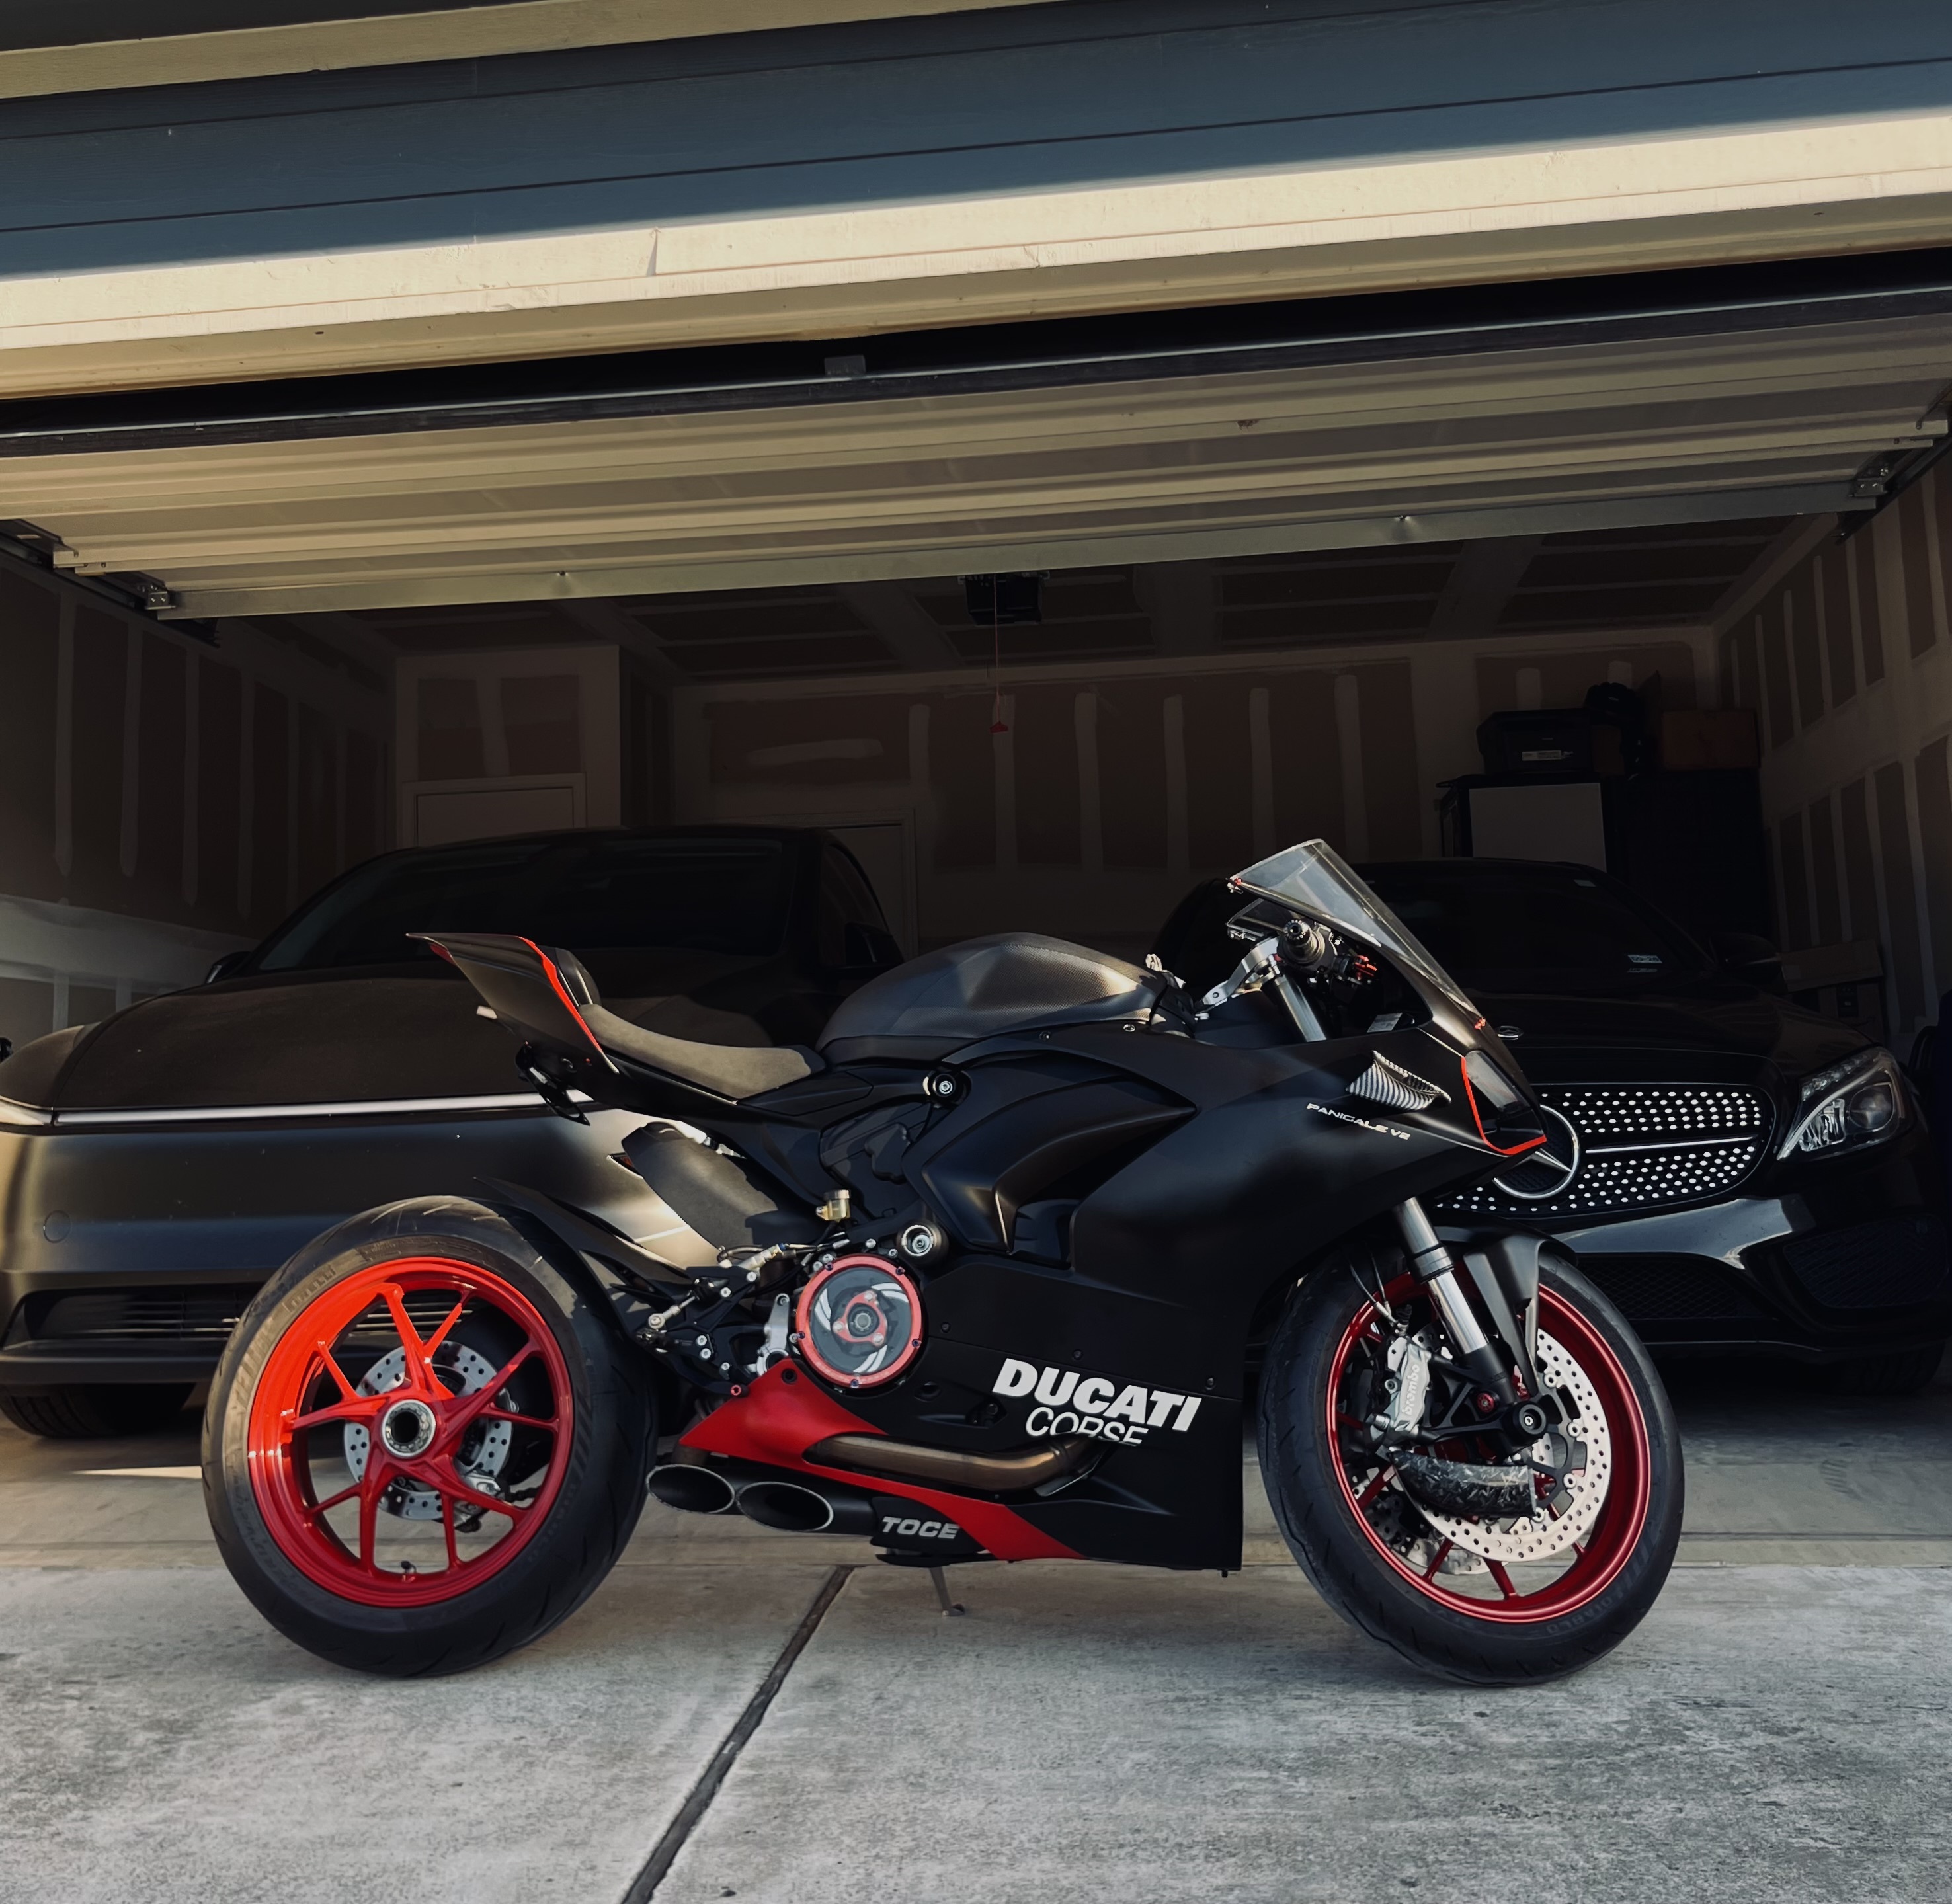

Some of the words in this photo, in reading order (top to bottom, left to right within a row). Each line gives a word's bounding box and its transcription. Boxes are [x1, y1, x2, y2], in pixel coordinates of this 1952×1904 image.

[1390, 1128, 1411, 1140] V2
[992, 1357, 1202, 1431] DUCATI
[1401, 1364, 1420, 1415] brembo
[882, 1515, 961, 1540] TOCE
